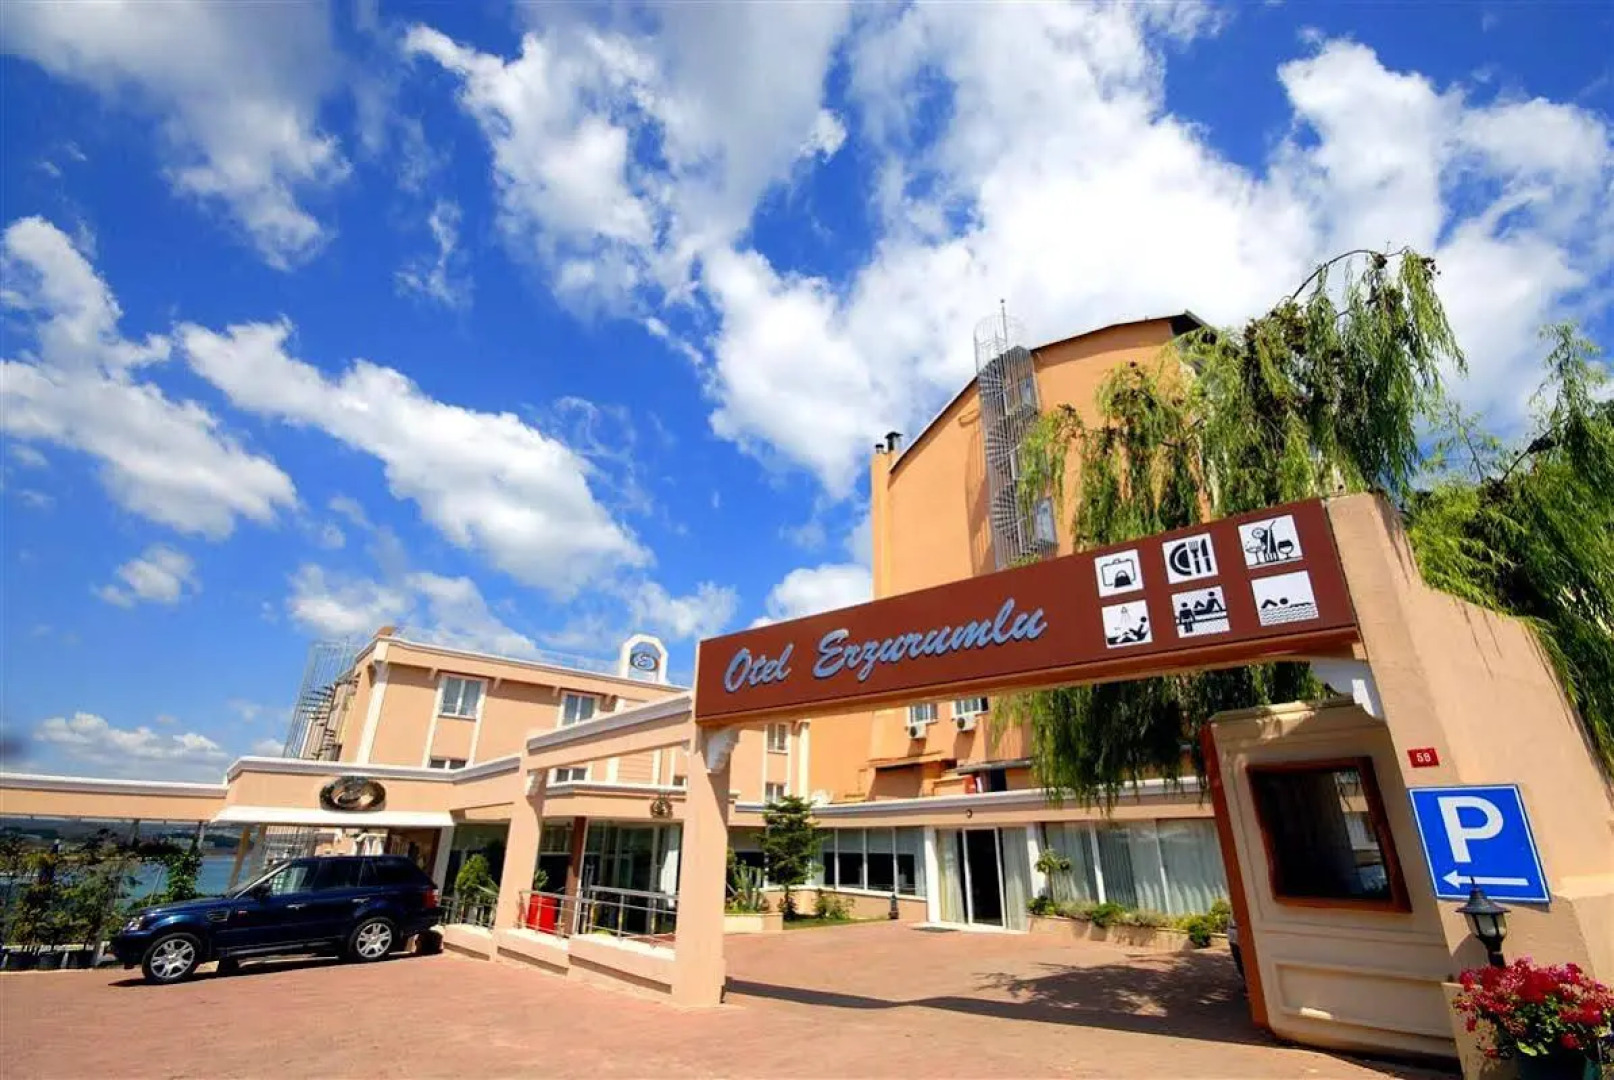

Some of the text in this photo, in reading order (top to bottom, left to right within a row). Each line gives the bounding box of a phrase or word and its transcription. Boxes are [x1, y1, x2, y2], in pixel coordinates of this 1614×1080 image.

[723, 597, 1047, 693] Otel Erzurumlu
[1416, 752, 1431, 763] 58
[1437, 796, 1504, 863] P
